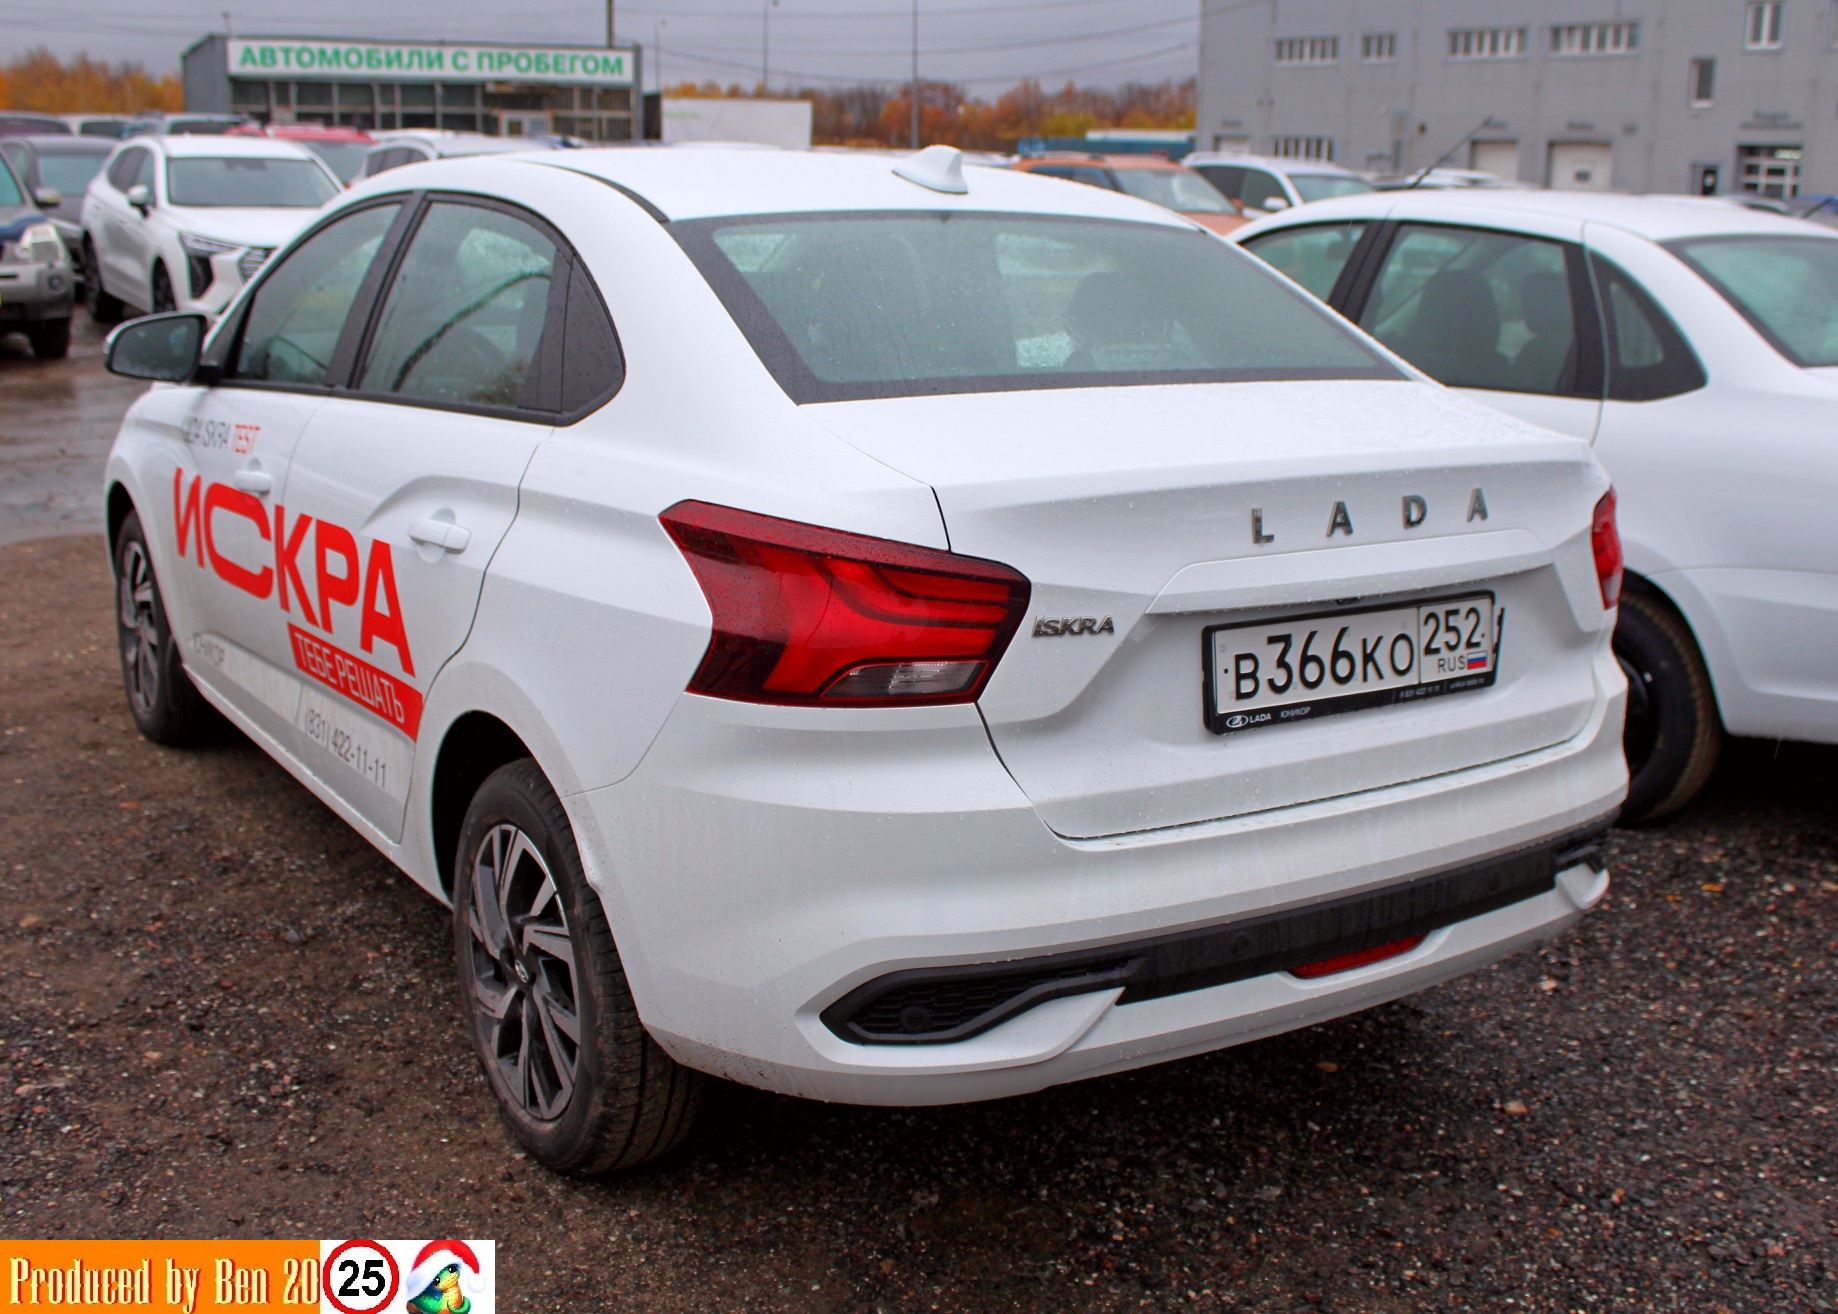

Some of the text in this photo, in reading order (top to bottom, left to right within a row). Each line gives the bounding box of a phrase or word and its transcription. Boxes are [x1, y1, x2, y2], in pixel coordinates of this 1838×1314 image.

[240, 45, 624, 76] АВТОМОБИЛИ С ПРОБЕГОМ
[174, 466, 416, 679] ИСКРА
[1031, 614, 1115, 637] ISKRA
[1234, 606, 1482, 701] В366КО 252
[1437, 655, 1467, 674] RUS
[294, 631, 338, 684] ТЕБЕ
[335, 653, 406, 725] РЕШАТЬ
[1249, 713, 1272, 723] LADA
[331, 727, 388, 789] 422-11-11
